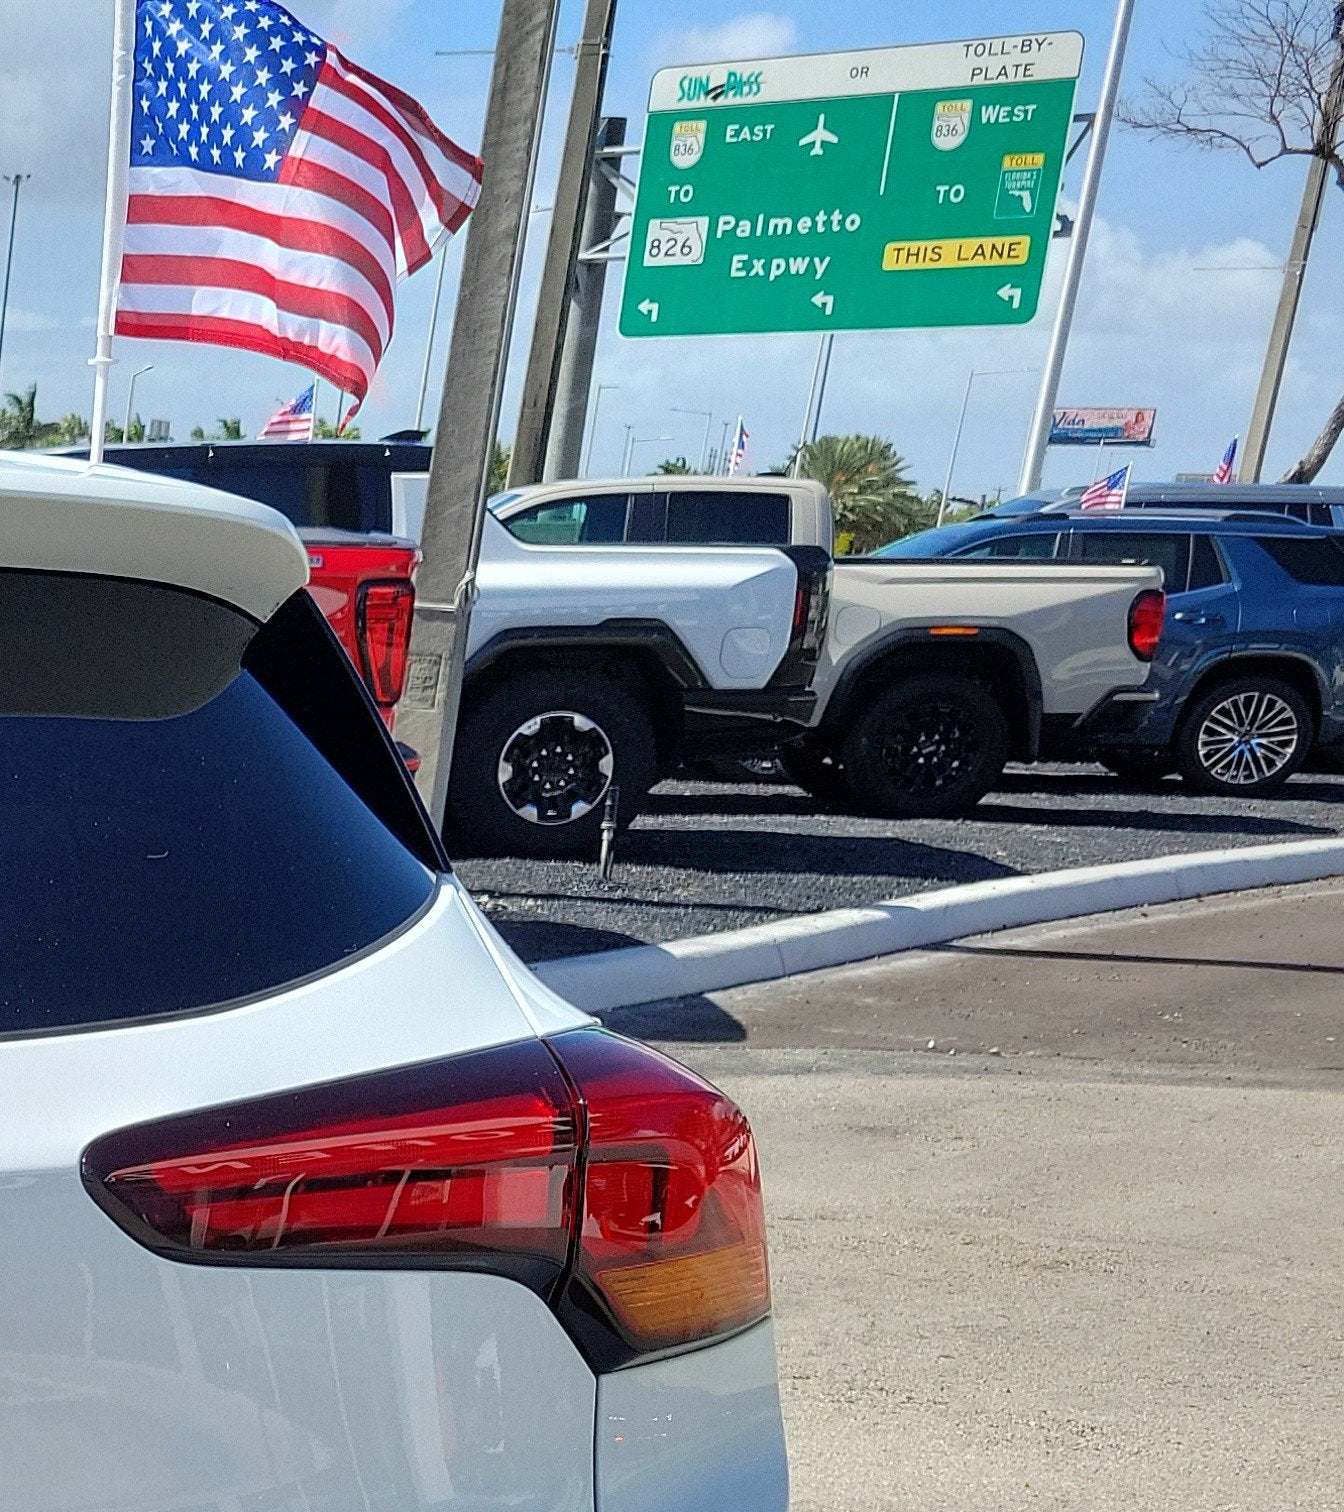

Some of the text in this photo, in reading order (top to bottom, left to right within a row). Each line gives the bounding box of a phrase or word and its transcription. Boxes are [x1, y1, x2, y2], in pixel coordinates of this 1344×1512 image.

[849, 66, 870, 79] OR
[970, 63, 1035, 82] PLATE
[942, 104, 966, 113] TOLL
[981, 104, 1038, 124] WEST
[678, 125, 701, 134] TOLL
[725, 124, 775, 143] EAST
[935, 124, 959, 139] 836
[673, 144, 694, 157] 836
[1009, 156, 1039, 167] TOLL
[667, 184, 694, 204] TO
[936, 184, 965, 204] TO
[716, 208, 861, 239] Palmetto
[648, 237, 693, 258] 826
[893, 241, 1022, 264] THIS LANE
[730, 254, 831, 281] Expwy
